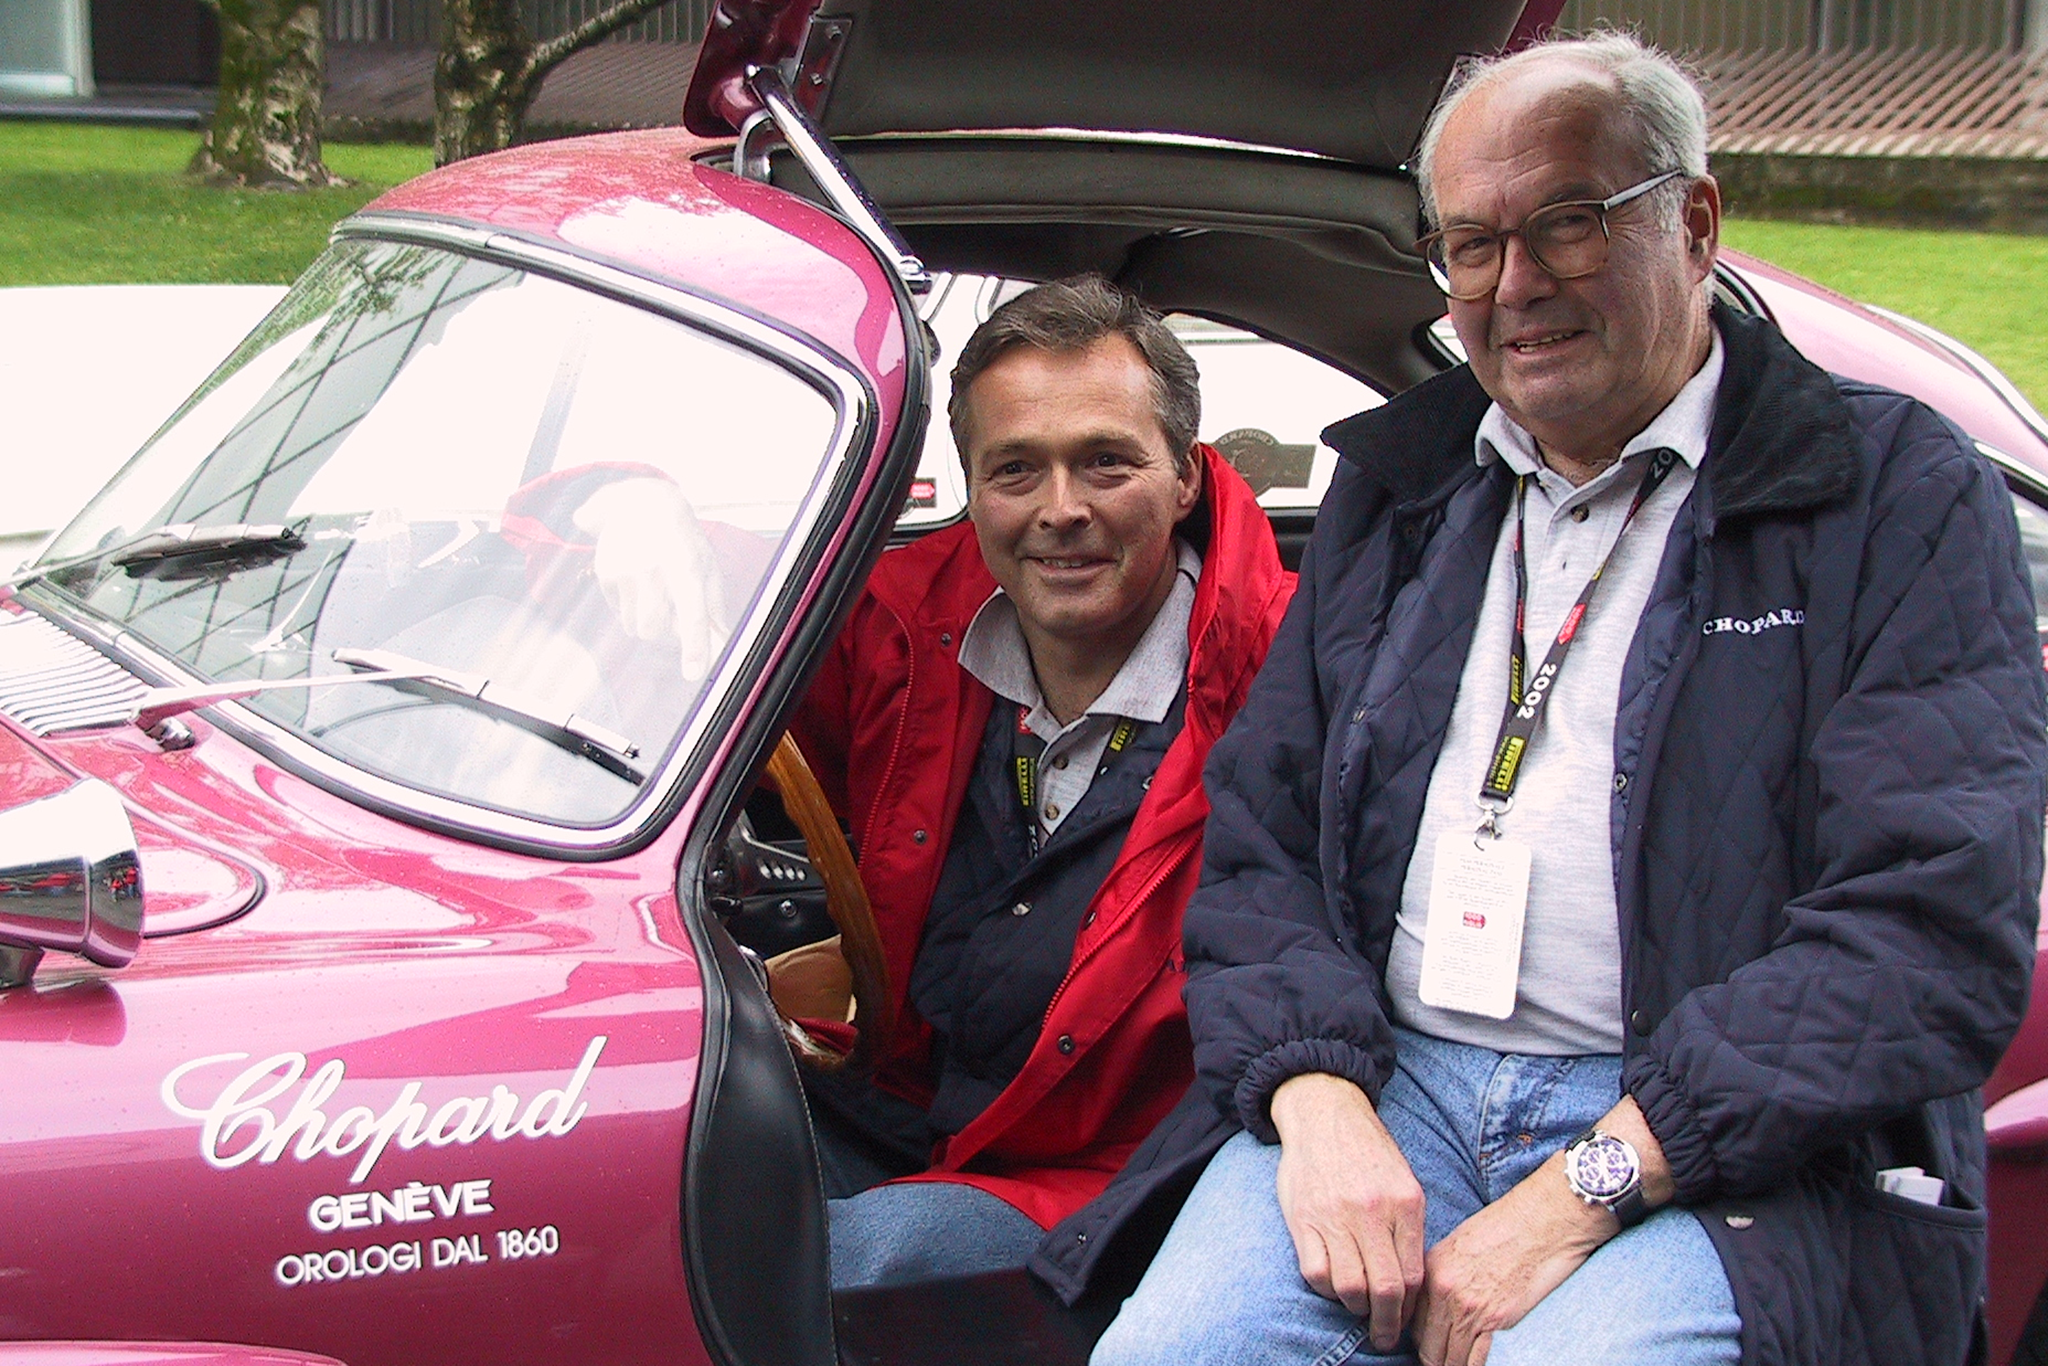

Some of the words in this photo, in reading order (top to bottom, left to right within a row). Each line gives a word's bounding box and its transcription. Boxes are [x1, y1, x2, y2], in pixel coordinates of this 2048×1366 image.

[1703, 608, 1805, 635] CHOPARD
[1517, 663, 1556, 719] 2002
[1494, 736, 1526, 791] PIRELLI
[161, 1036, 607, 1184] Chopard
[309, 1178, 494, 1232] GENÈVE
[276, 1240, 422, 1286] OROLOGI
[433, 1233, 488, 1267] DAL
[497, 1225, 560, 1258] 1860
